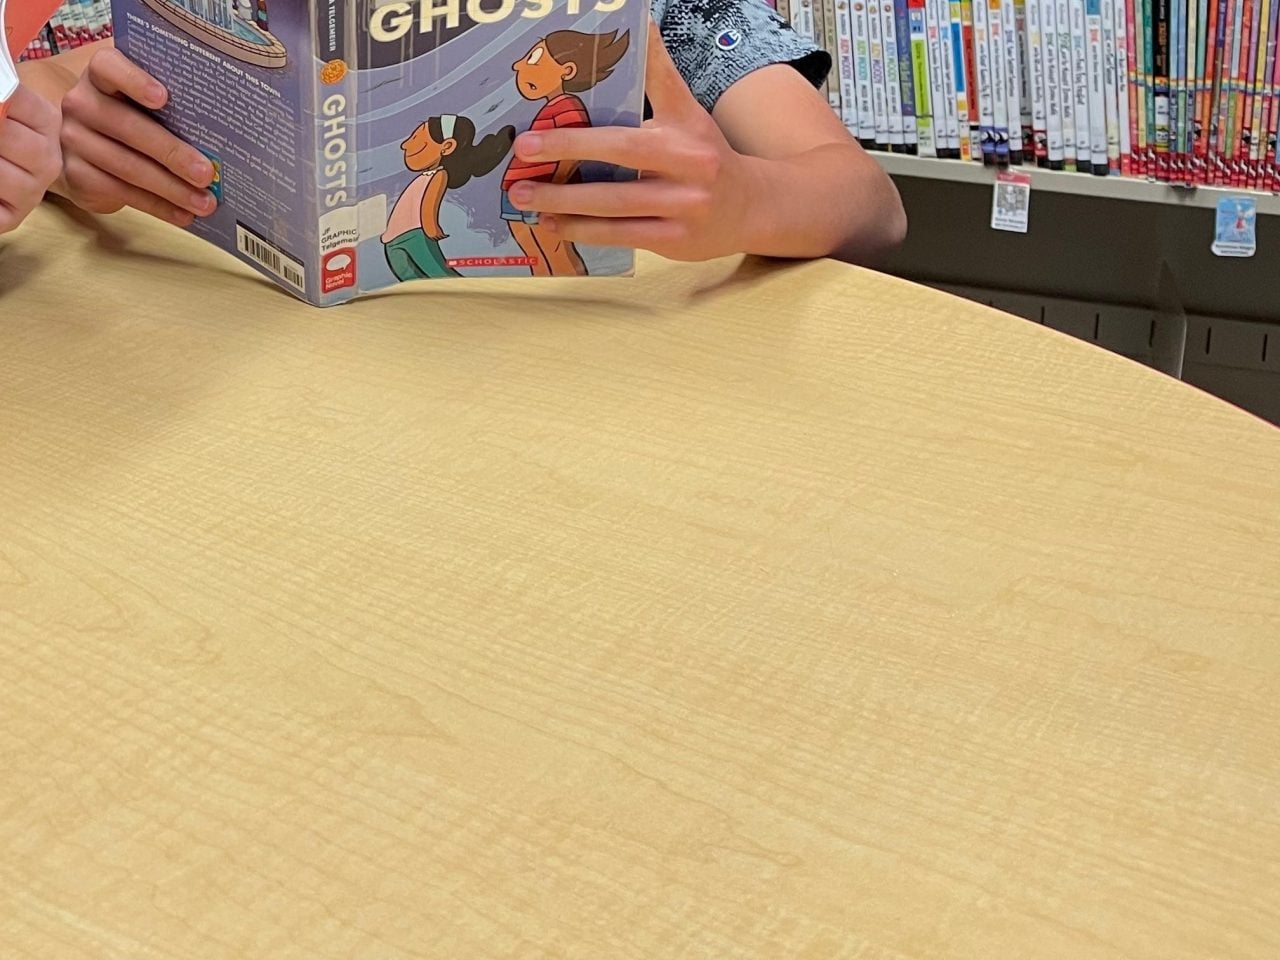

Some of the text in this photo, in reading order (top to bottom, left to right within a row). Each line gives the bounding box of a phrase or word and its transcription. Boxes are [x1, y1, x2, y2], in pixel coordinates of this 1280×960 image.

[329, 2, 337, 53] TELGEMEIER
[151, 24, 189, 47] SOMETHING
[189, 42, 221, 64] DIFFERENT
[222, 60, 244, 77] ABOUT
[245, 72, 260, 86] THIS
[260, 81, 281, 98] TOWN
[322, 94, 347, 208] GHOSTS
[321, 228, 357, 244] GRAPHIC
[459, 257, 537, 266] SCHOLASTIC
